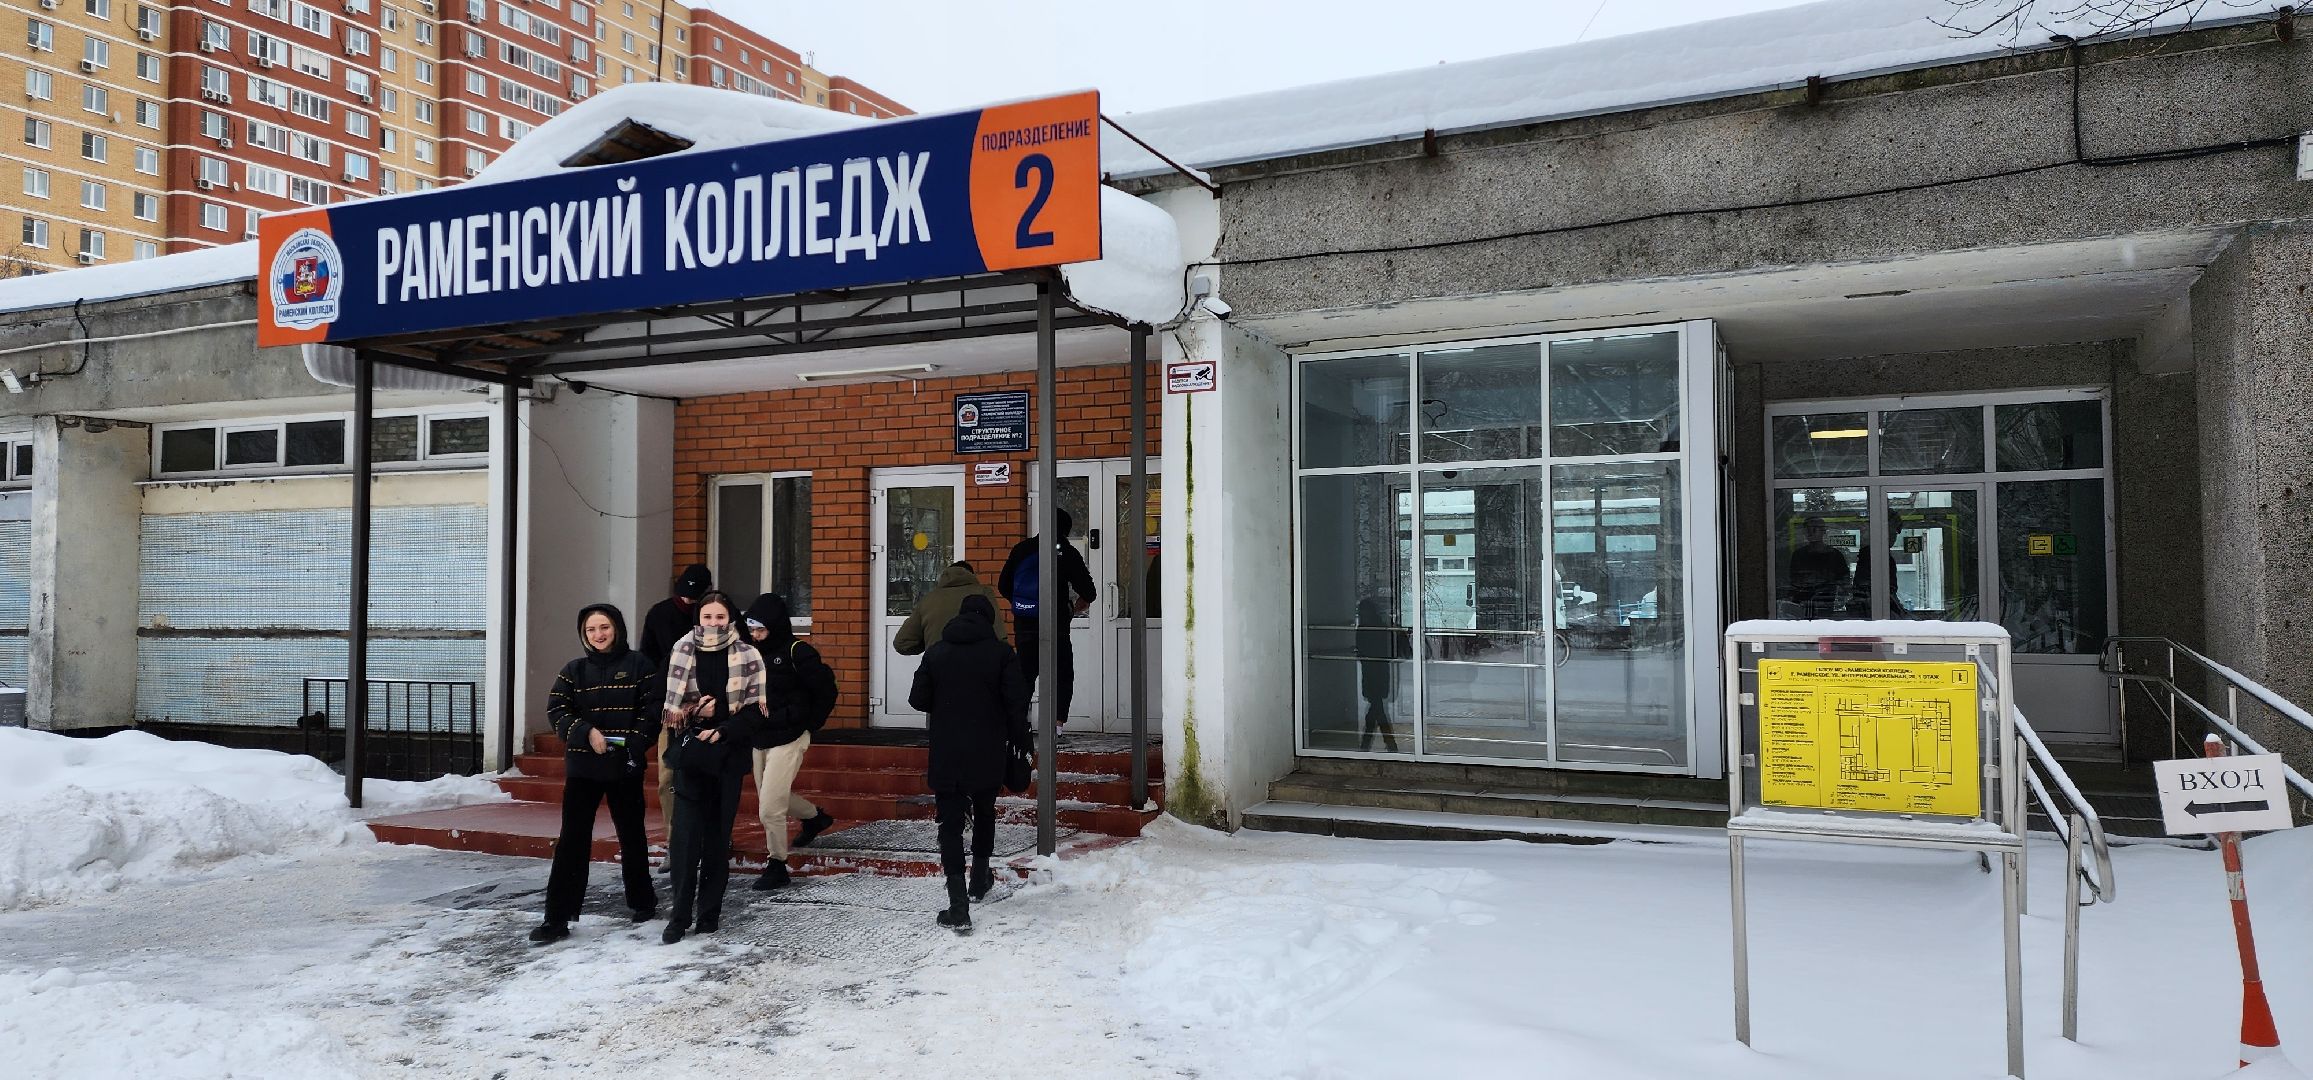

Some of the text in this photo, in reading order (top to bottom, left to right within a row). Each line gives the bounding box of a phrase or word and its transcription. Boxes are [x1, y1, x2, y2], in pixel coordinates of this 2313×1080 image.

[981, 118, 1092, 153] ПОДРАЗДЕЛЕНИЕ
[1013, 153, 1055, 249] 2
[377, 150, 932, 305] РАМЕНСКИЙ КОЛЛЕДЖ
[279, 304, 334, 318] РАМЕНСКИЙ КОЛЛЕДЖ
[2179, 768, 2265, 792] ВХОД
